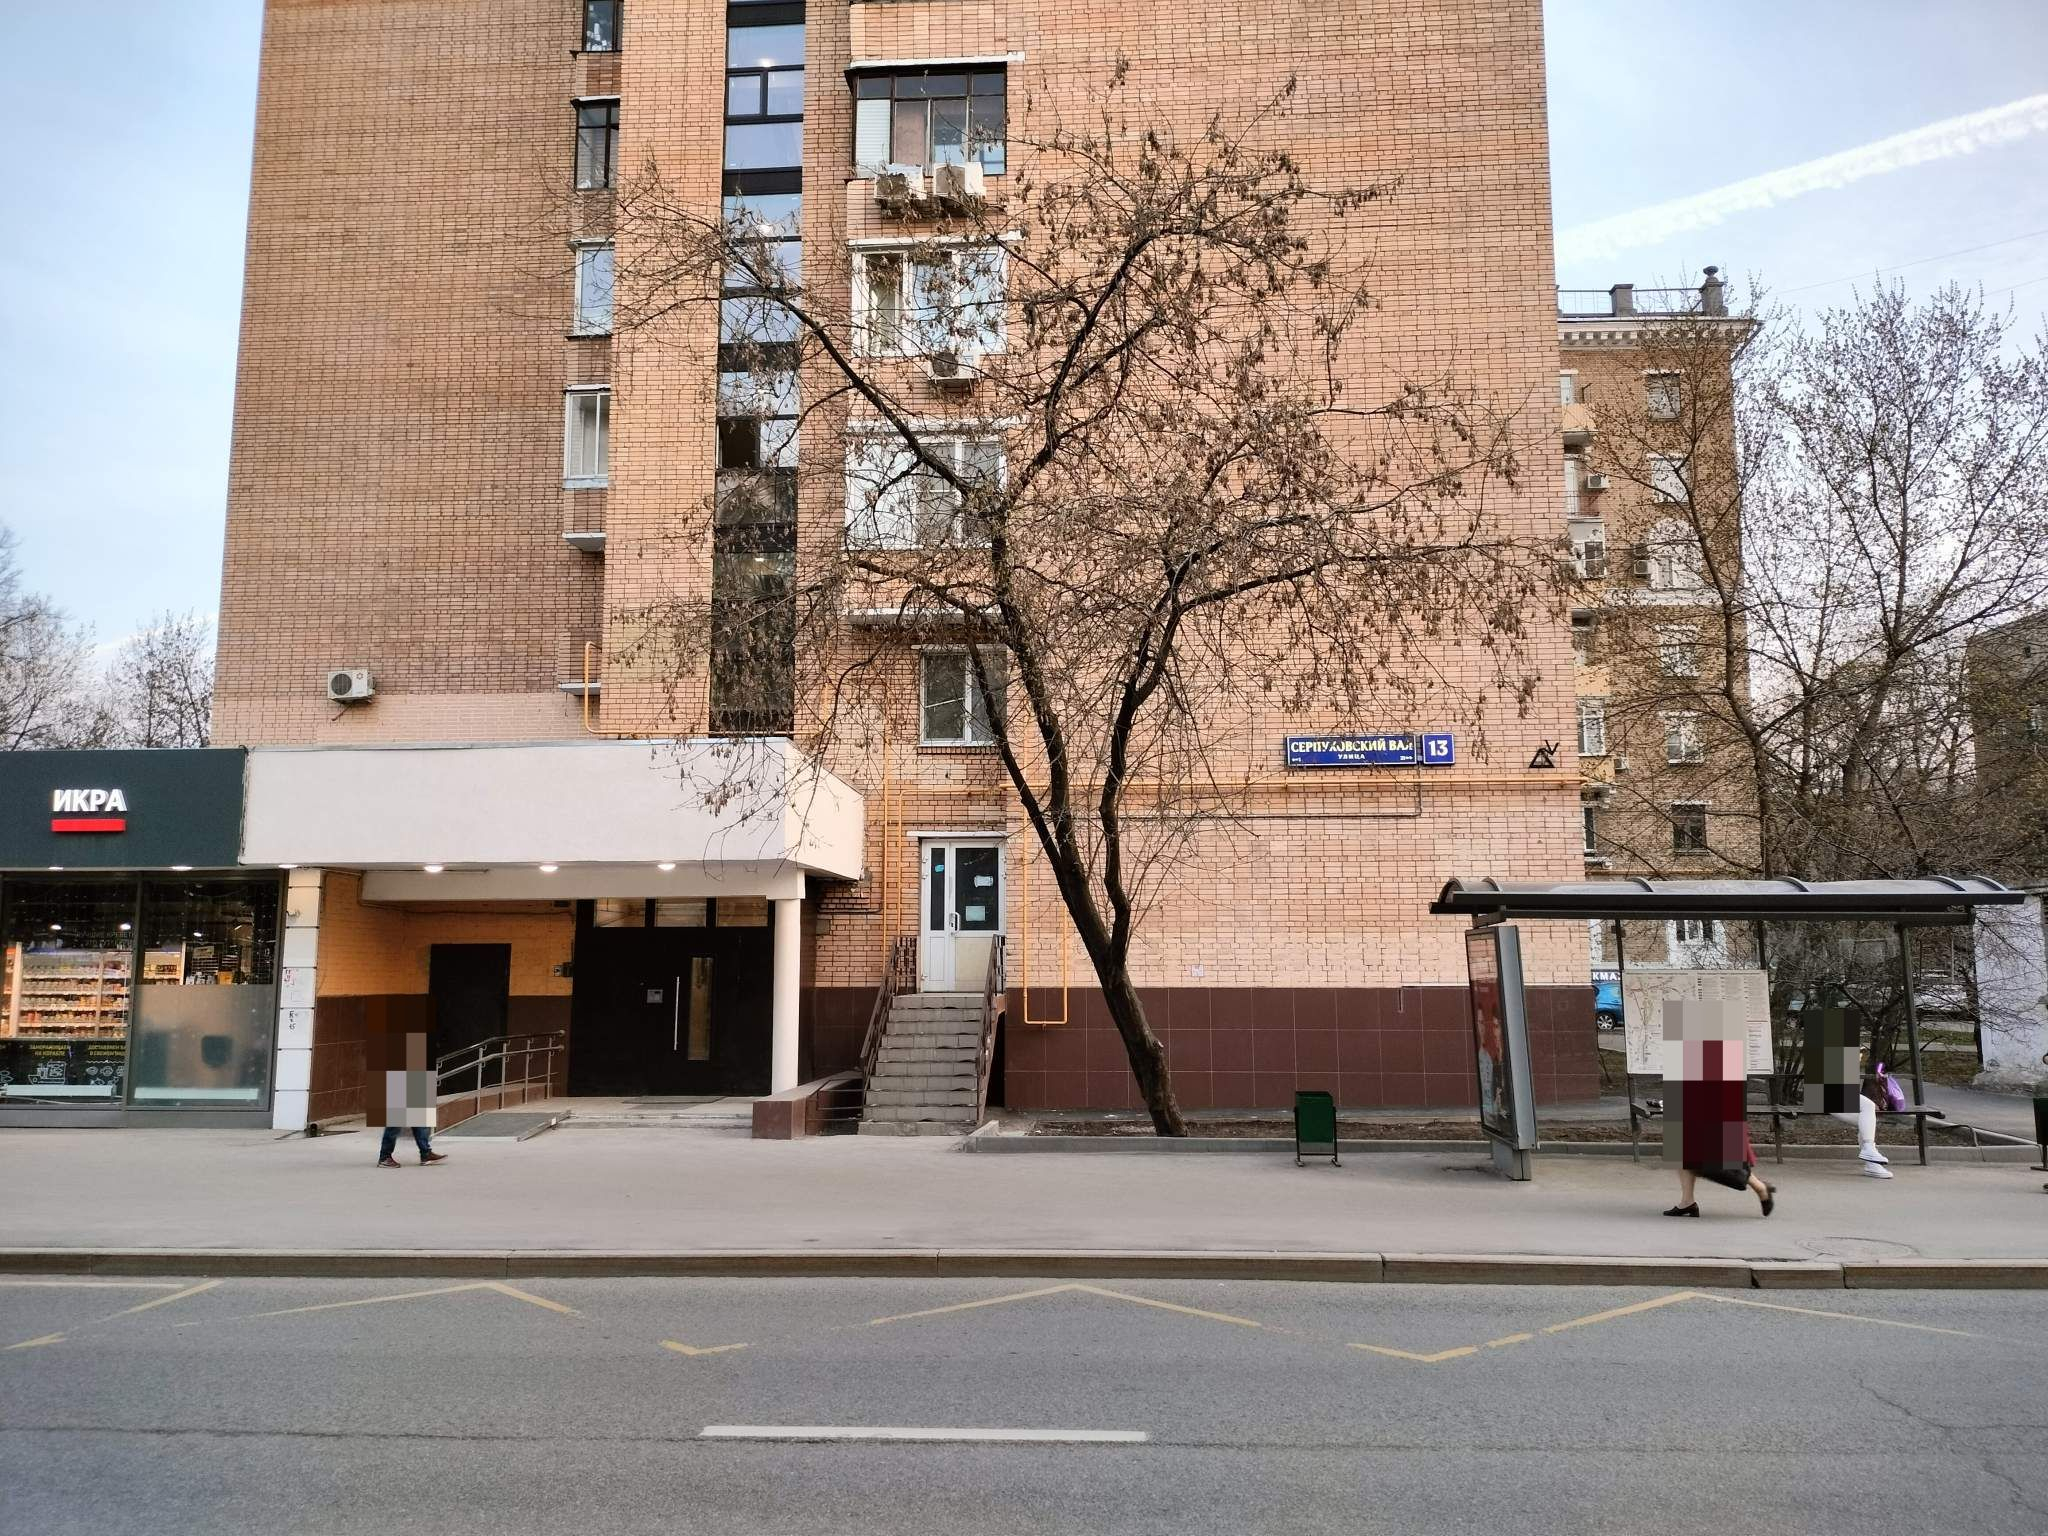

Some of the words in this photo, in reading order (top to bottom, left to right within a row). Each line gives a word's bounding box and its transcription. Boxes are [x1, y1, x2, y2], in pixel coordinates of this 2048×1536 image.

[1290, 740, 1386, 753] СЕРПУХОВСКИЙ
[1428, 740, 1449, 756] 13
[53, 789, 127, 812] ИКРА
